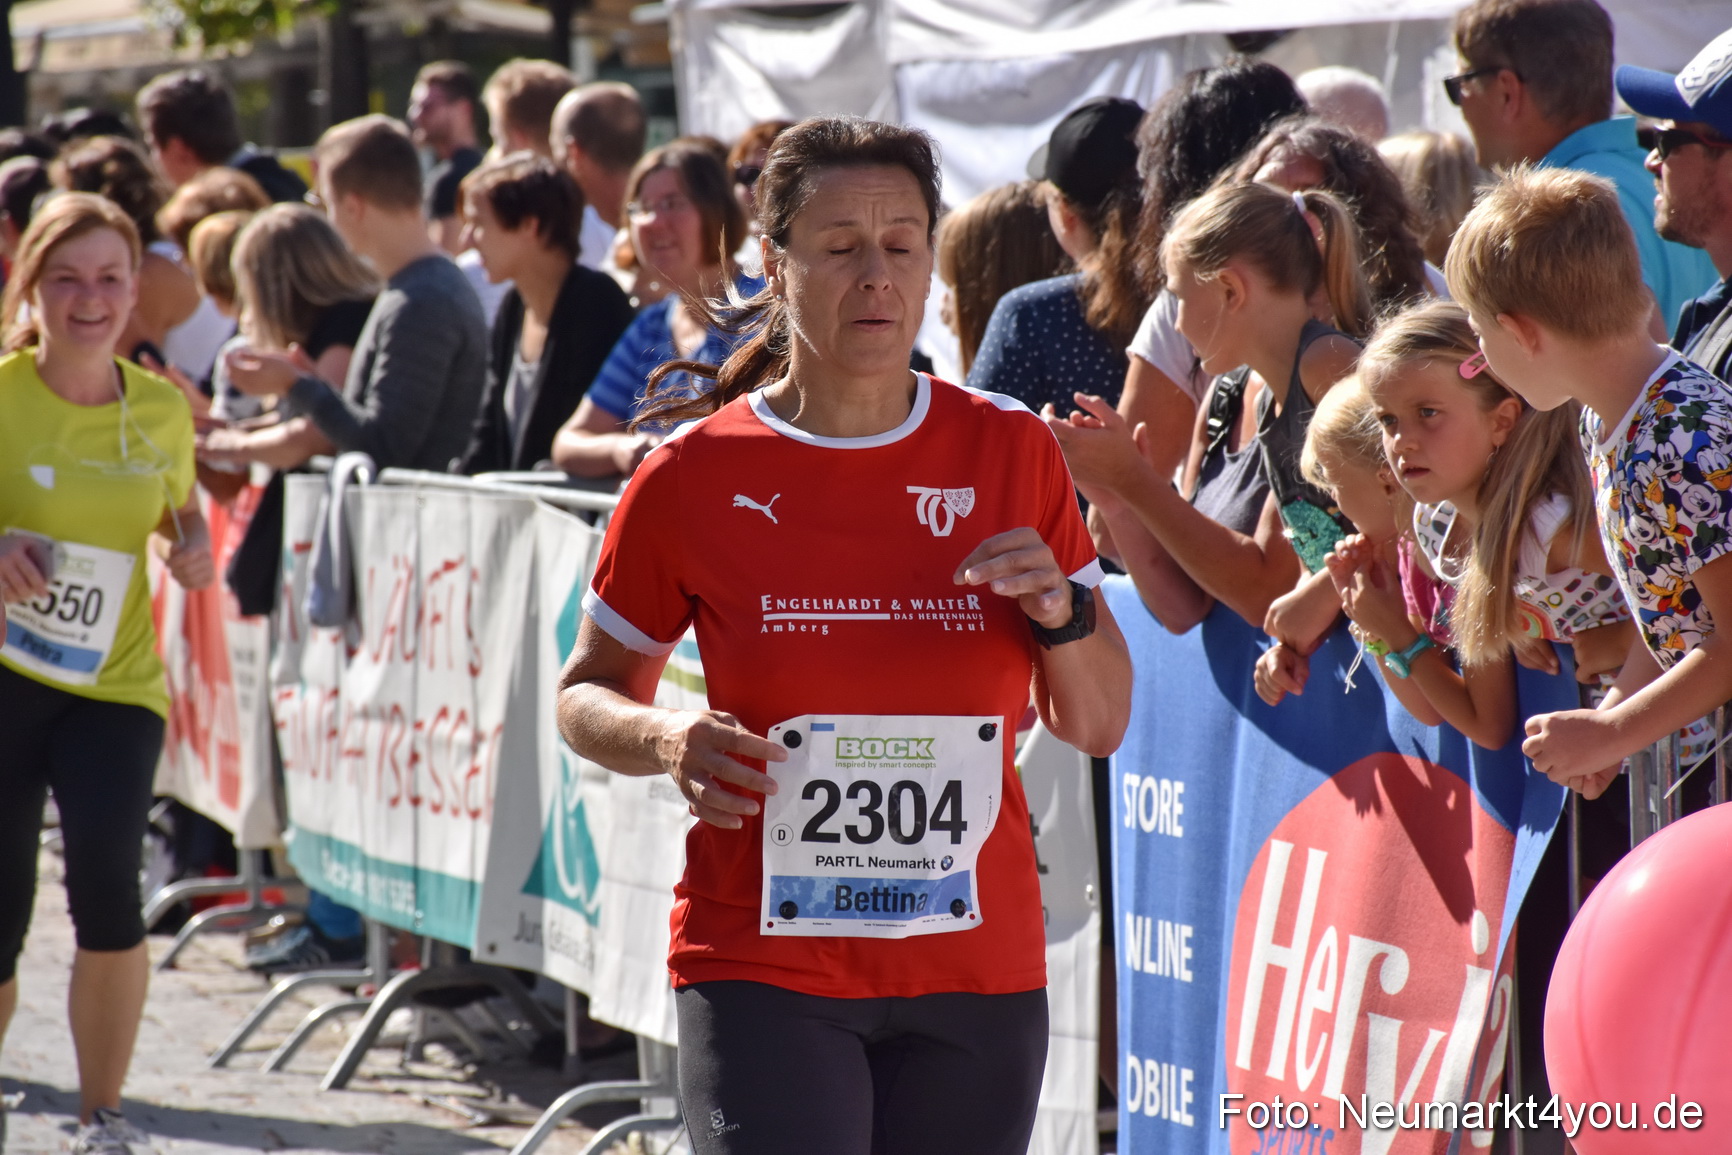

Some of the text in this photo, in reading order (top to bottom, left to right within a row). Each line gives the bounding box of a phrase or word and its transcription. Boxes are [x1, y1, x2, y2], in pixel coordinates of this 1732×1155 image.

[761, 594, 981, 611] ENGELHARDT & WALTER
[894, 613, 984, 621] DAS HERRENHAUS
[761, 621, 985, 635] Amberg Lauf
[836, 737, 936, 760] BOCK
[835, 761, 866, 770] inspired
[868, 761, 877, 770] by
[903, 762, 937, 771] concepts
[800, 779, 968, 846] 2304
[1123, 772, 1185, 838] STORE
[815, 855, 936, 870] PARTL Neumarkt
[834, 884, 929, 914] Bettina
